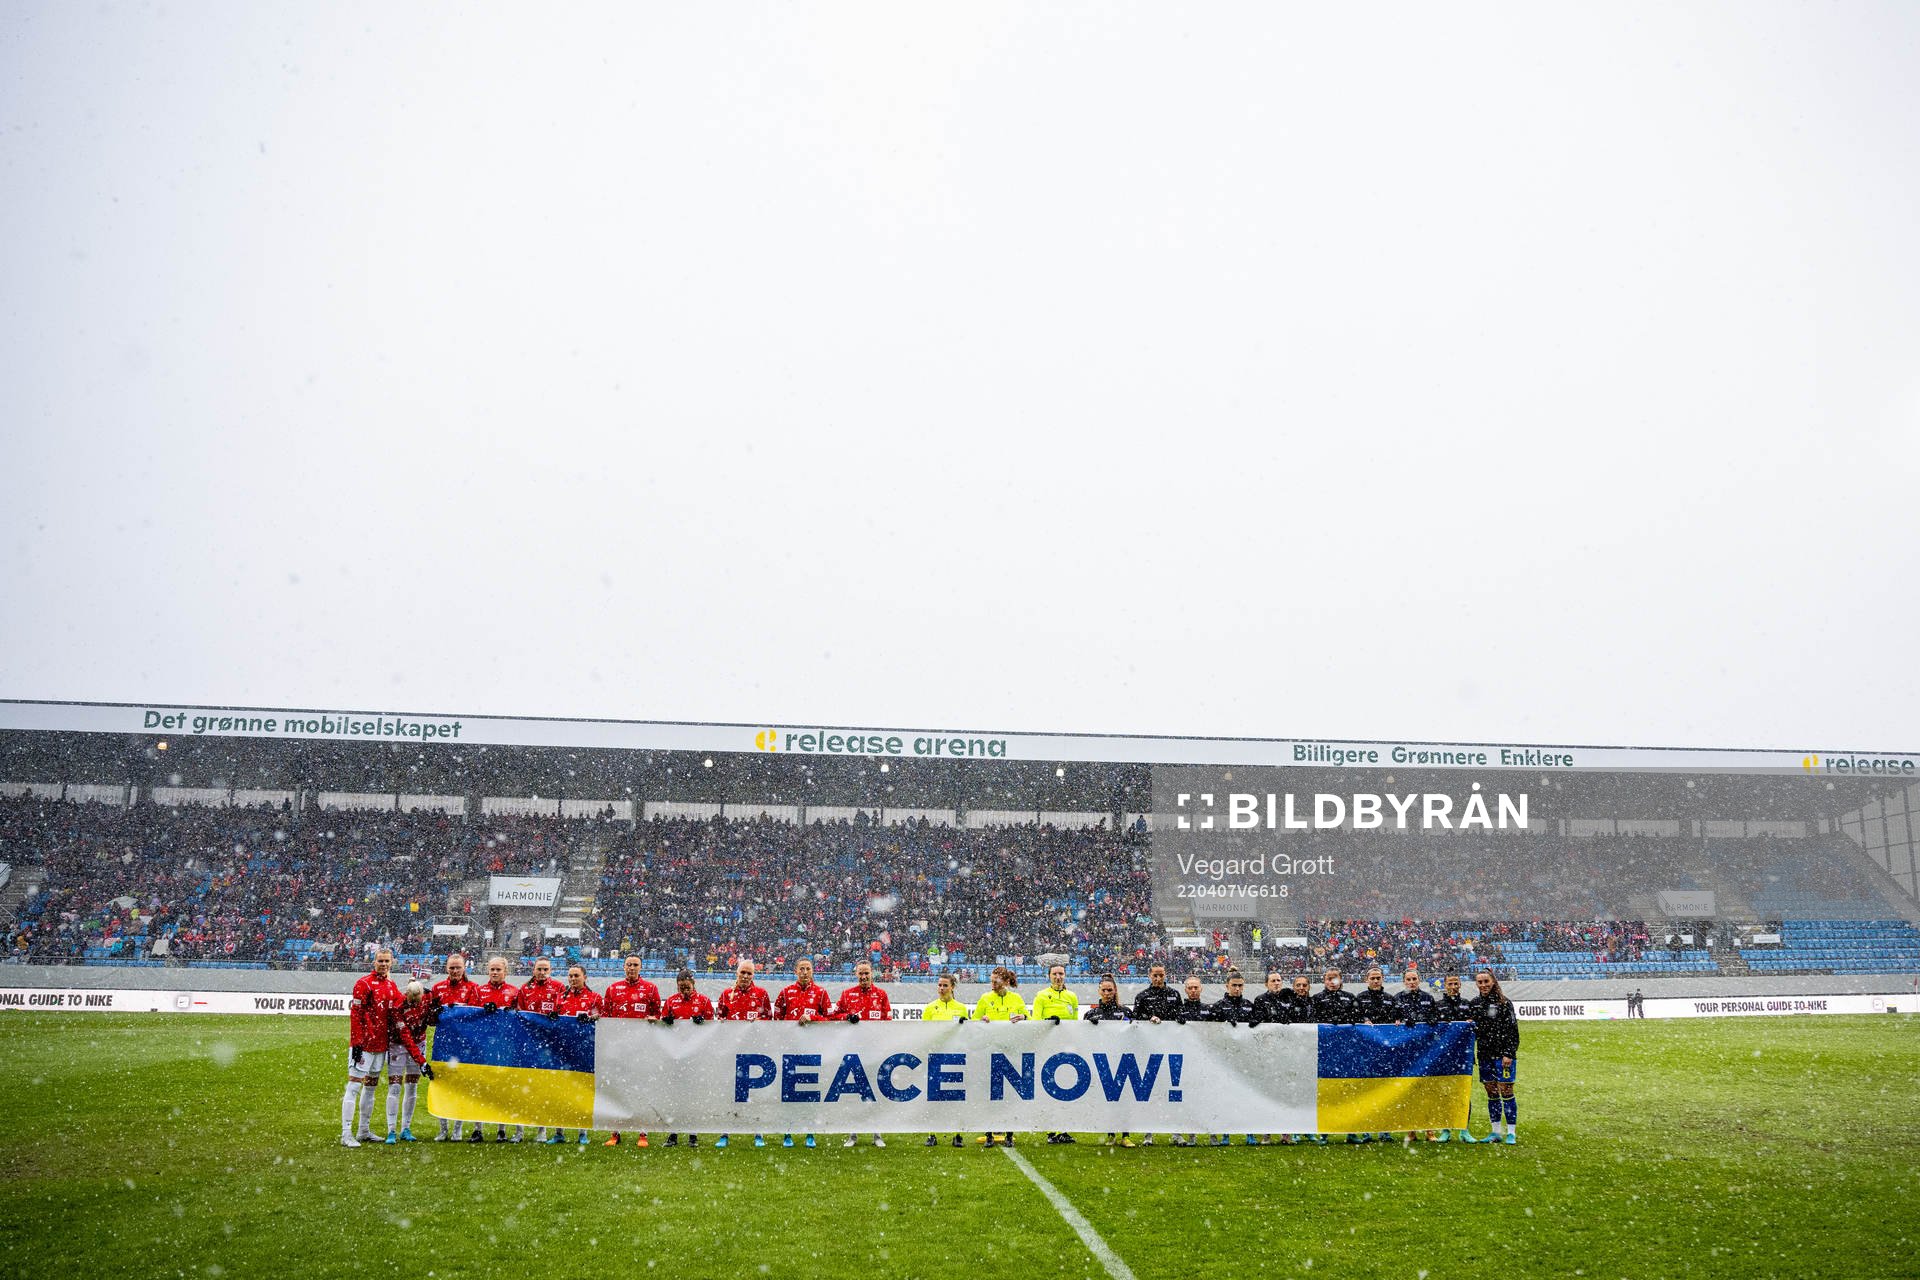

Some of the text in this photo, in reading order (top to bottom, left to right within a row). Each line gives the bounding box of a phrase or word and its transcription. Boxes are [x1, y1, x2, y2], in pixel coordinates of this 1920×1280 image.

[143, 710, 462, 741] Det grønne mobilselskapet
[784, 730, 1007, 757] release arena
[1292, 744, 1574, 767] Billigere Grønnere Enklere
[1825, 755, 1915, 775] release
[497, 891, 553, 901] HARMONIE
[1199, 903, 1249, 912] HARMONIE
[29, 993, 65, 1006] GUIDE
[68, 994, 82, 1006] TO
[85, 994, 113, 1007] NIKE
[254, 998, 286, 1010] YOUR
[288, 998, 345, 1011] PERSONAL
[1694, 1002, 1719, 1013] YOUR
[1721, 1001, 1765, 1012] PERSONAL
[1766, 1000, 1792, 1011] GUIDE
[1807, 1000, 1828, 1010] NIKE
[1519, 1005, 1585, 1016] GUIDE TO NIKE
[734, 1052, 1184, 1103] PEACE NOW!
